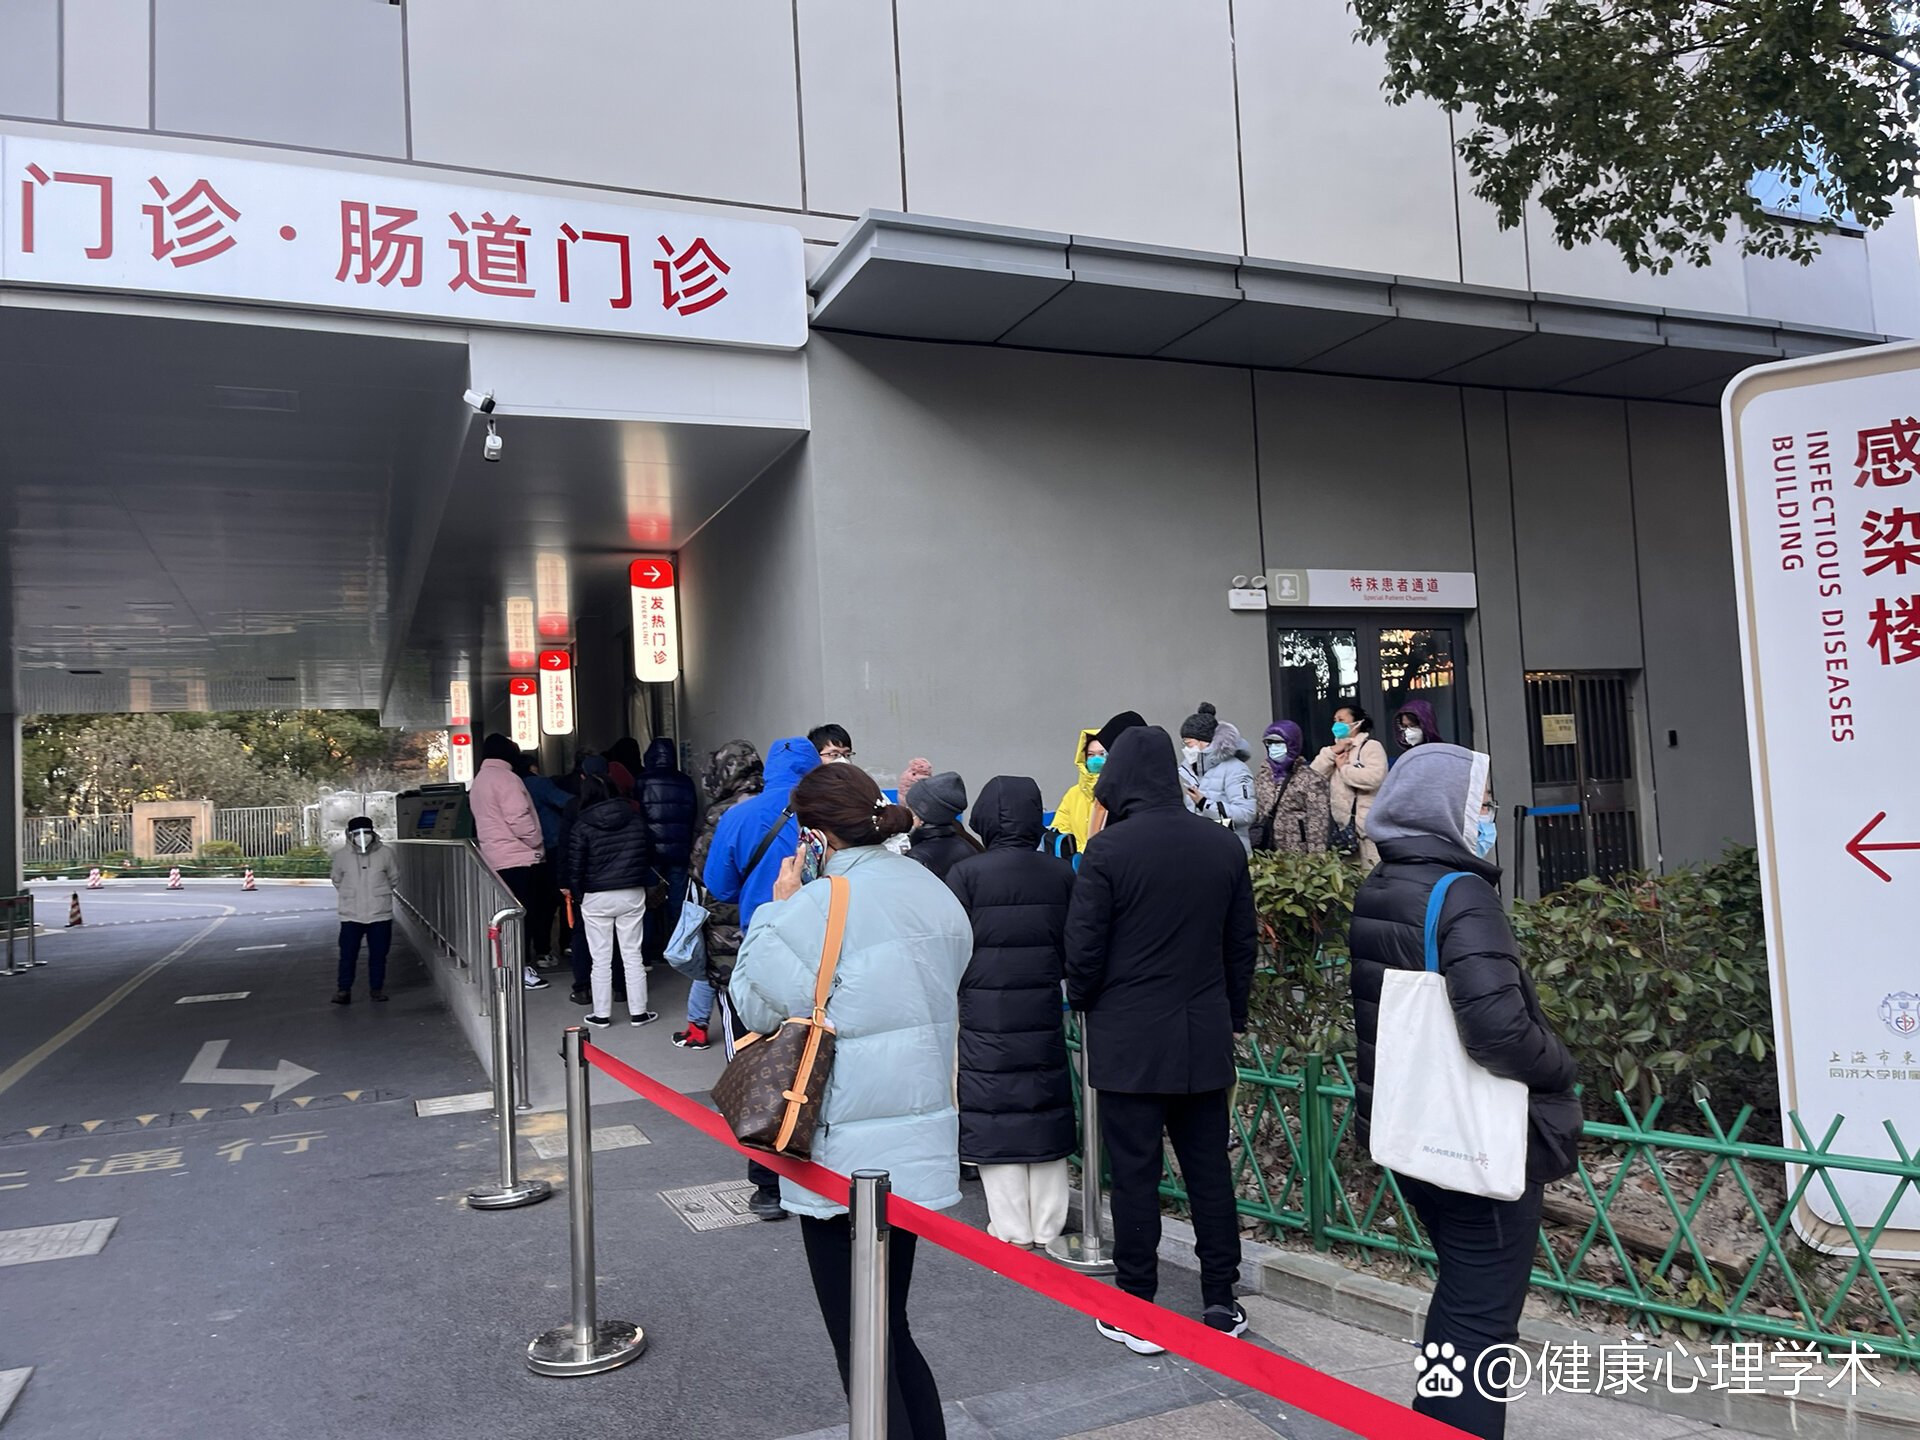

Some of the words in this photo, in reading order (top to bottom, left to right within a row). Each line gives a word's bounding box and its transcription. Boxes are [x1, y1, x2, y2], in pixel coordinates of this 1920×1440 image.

[1772, 435, 1804, 571] BUILDING
[1806, 430, 1842, 598] INFECTIOUS
[1854, 416, 1920, 666] 感染楼
[651, 596, 668, 665] 发热门诊
[1350, 577, 1439, 592] 特殊患者通道
[1821, 609, 1854, 742] DISEASES
